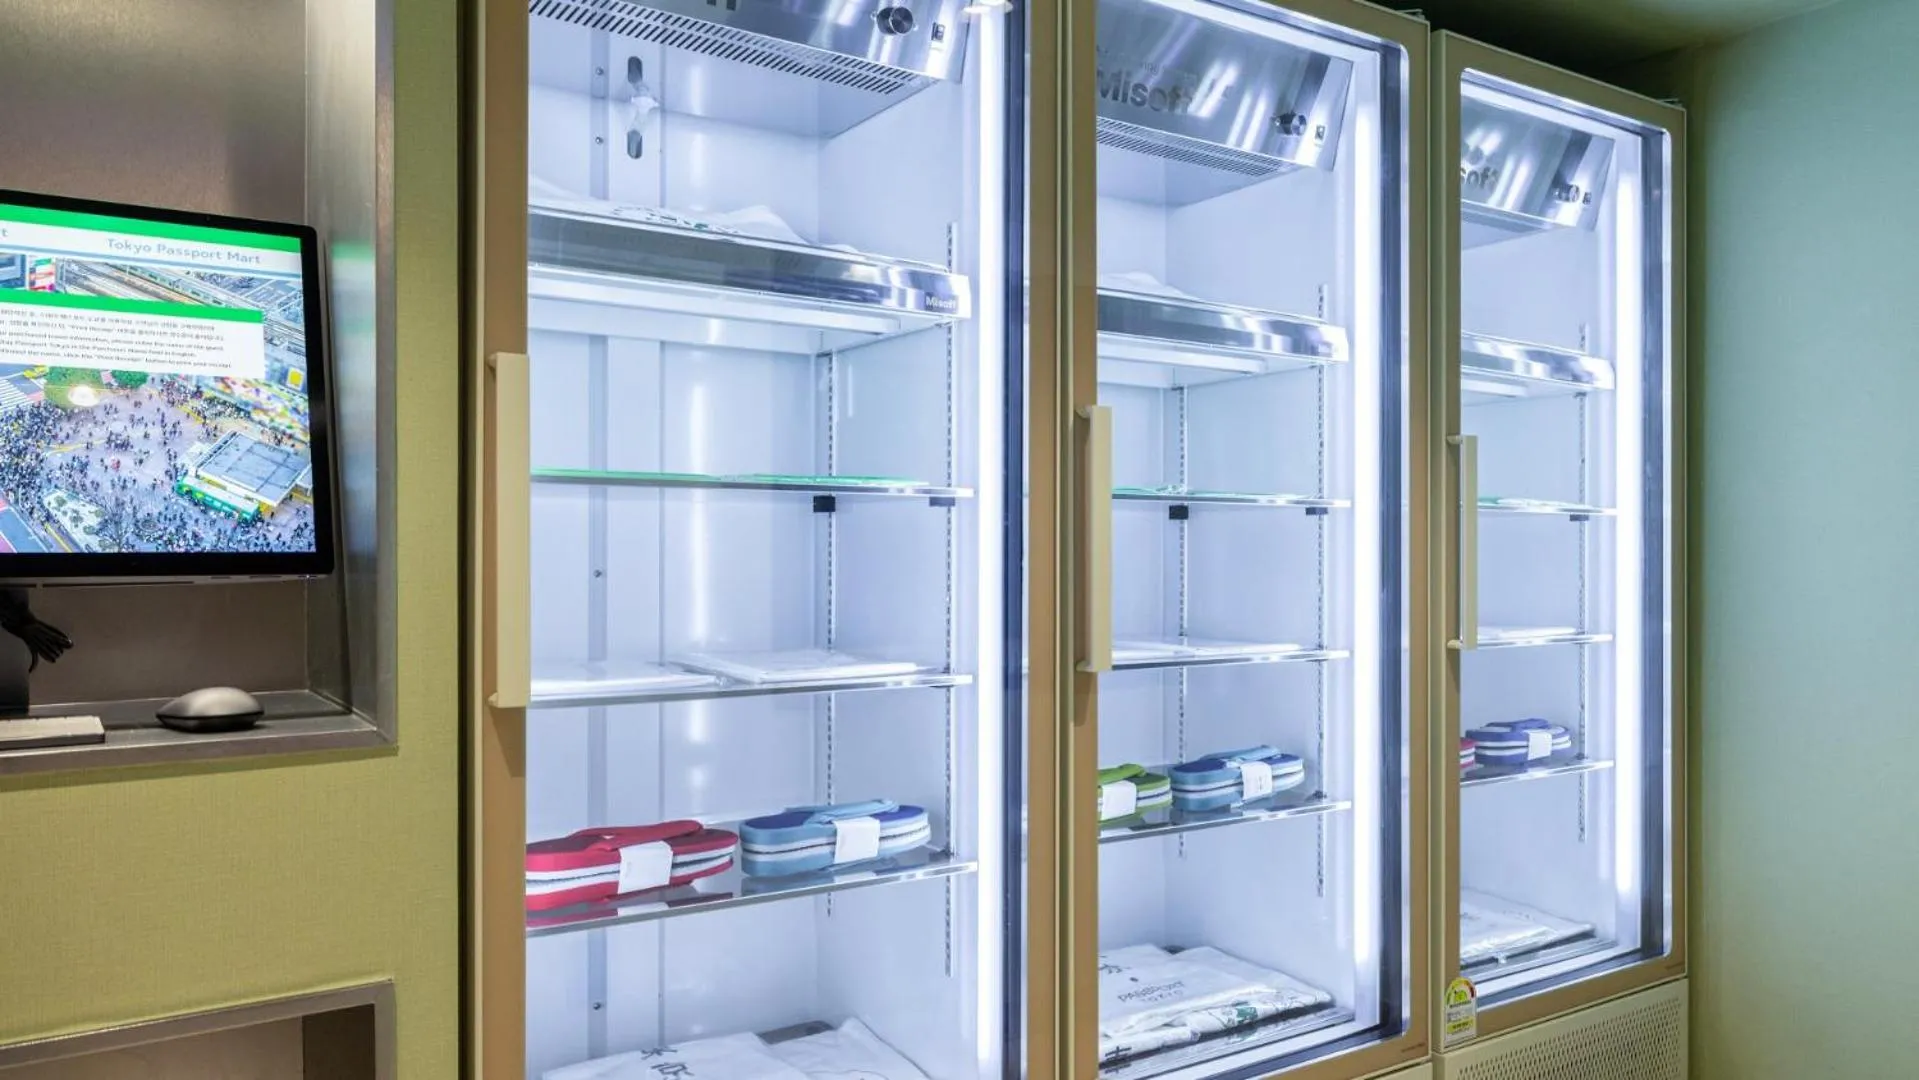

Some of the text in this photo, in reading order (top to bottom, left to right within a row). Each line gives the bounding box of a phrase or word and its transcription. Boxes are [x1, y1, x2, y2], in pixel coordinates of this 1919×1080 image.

[107, 238, 261, 265] Tokyo Passport Mart
